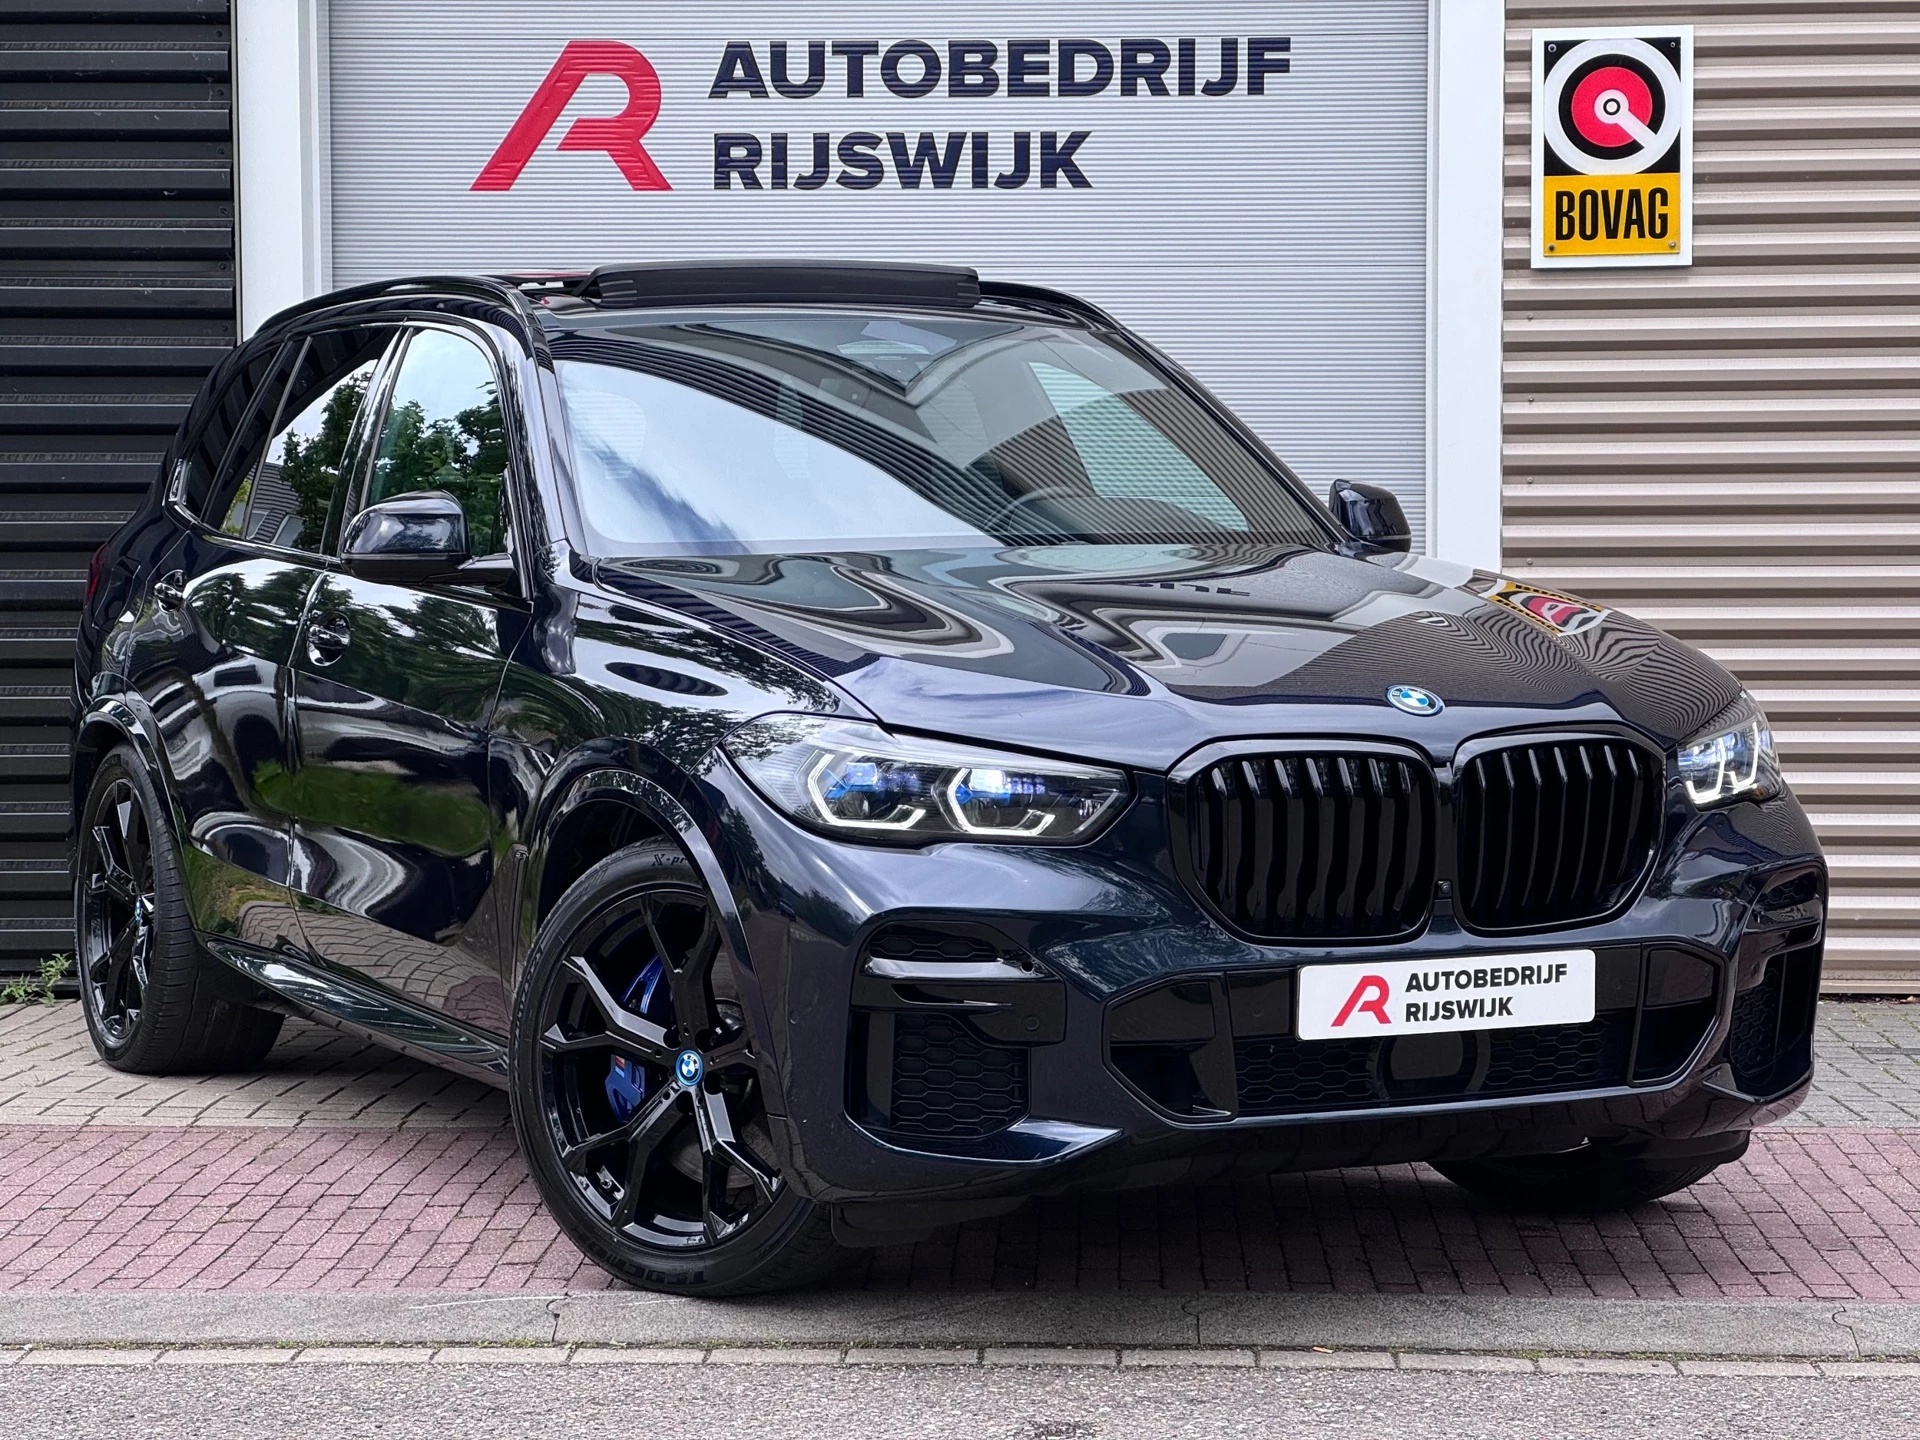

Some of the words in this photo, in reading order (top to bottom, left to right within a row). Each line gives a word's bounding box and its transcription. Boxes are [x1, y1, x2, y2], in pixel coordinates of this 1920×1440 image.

[708, 37, 1292, 99] AUTOBEDRIJF
[713, 131, 1093, 191] RIJSWIJK
[1555, 187, 1669, 241] BOVAG
[1405, 963, 1568, 993] AUTOBEDRIJF
[1405, 996, 1514, 1023] RIJSWIJK
